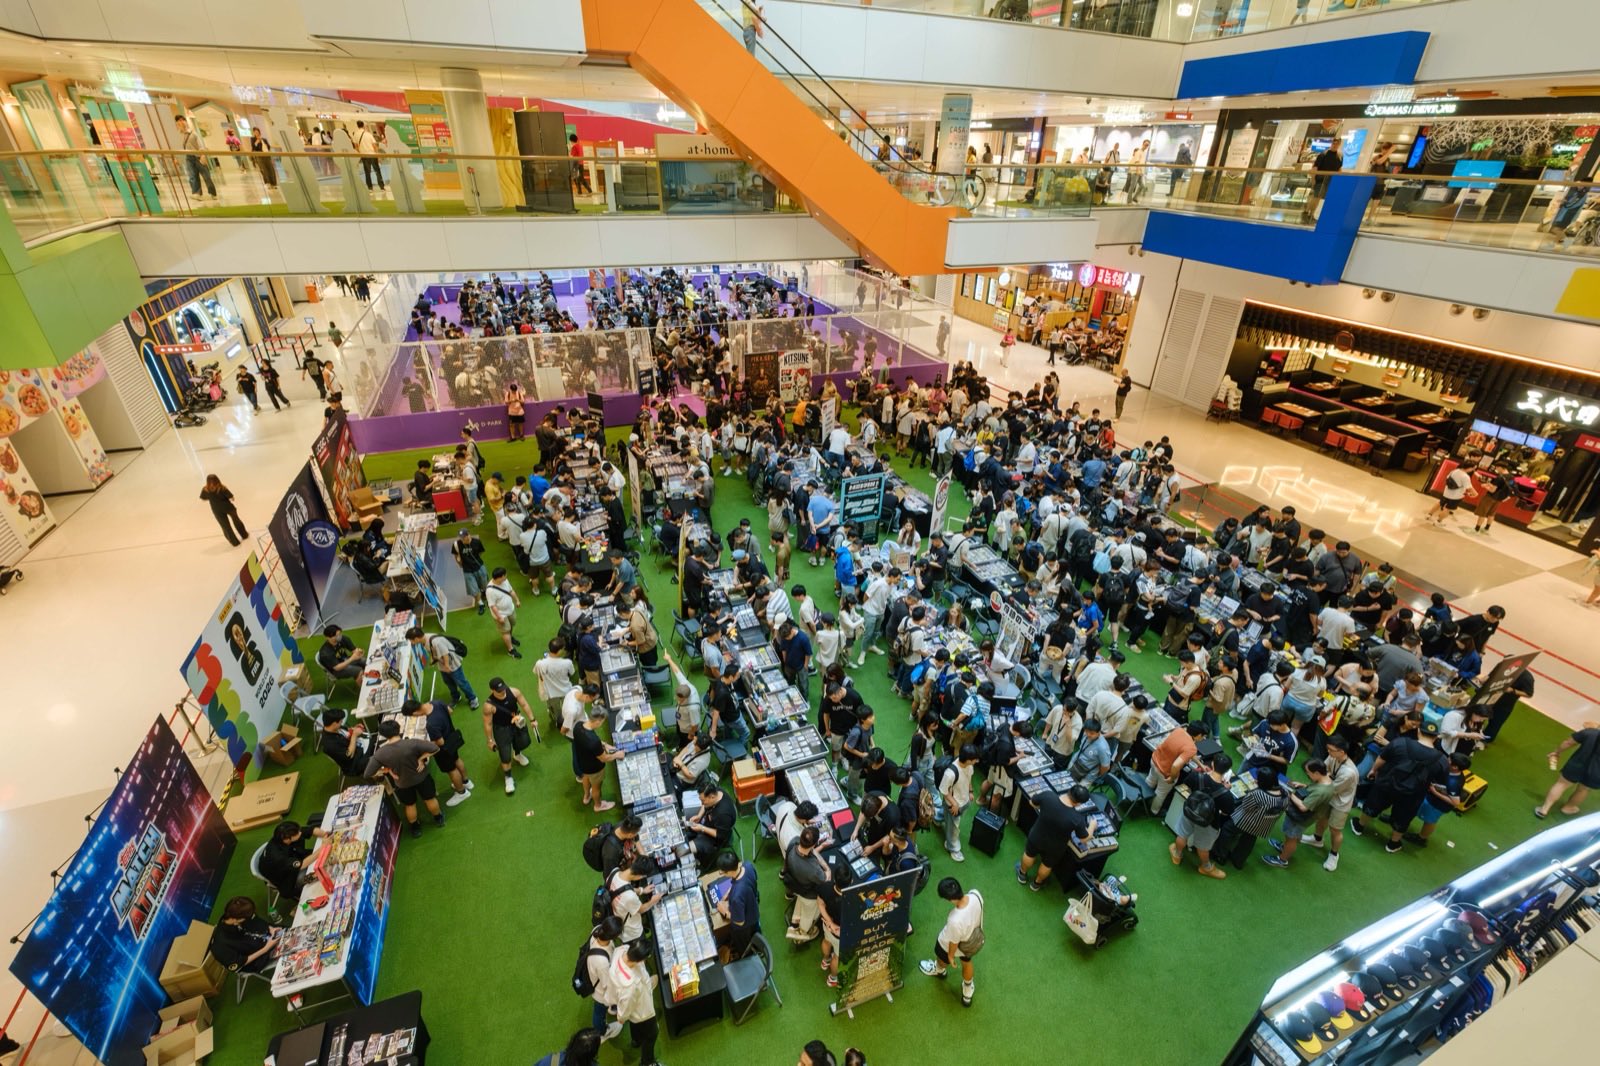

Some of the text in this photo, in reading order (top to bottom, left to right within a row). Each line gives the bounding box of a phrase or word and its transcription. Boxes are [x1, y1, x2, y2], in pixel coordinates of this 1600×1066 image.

[783, 352, 809, 366] KITSUNE
[251, 660, 261, 677] FIFA
[255, 678, 266, 699] WORLD
[259, 674, 275, 709] 2026
[110, 822, 162, 919] MATCH
[128, 842, 177, 940] ATTAX
[141, 904, 158, 938] TRADING
[862, 907, 894, 920] UNCLES
[861, 931, 892, 945] SELL
[864, 922, 888, 936] BUY
[856, 938, 895, 956] TRADE
